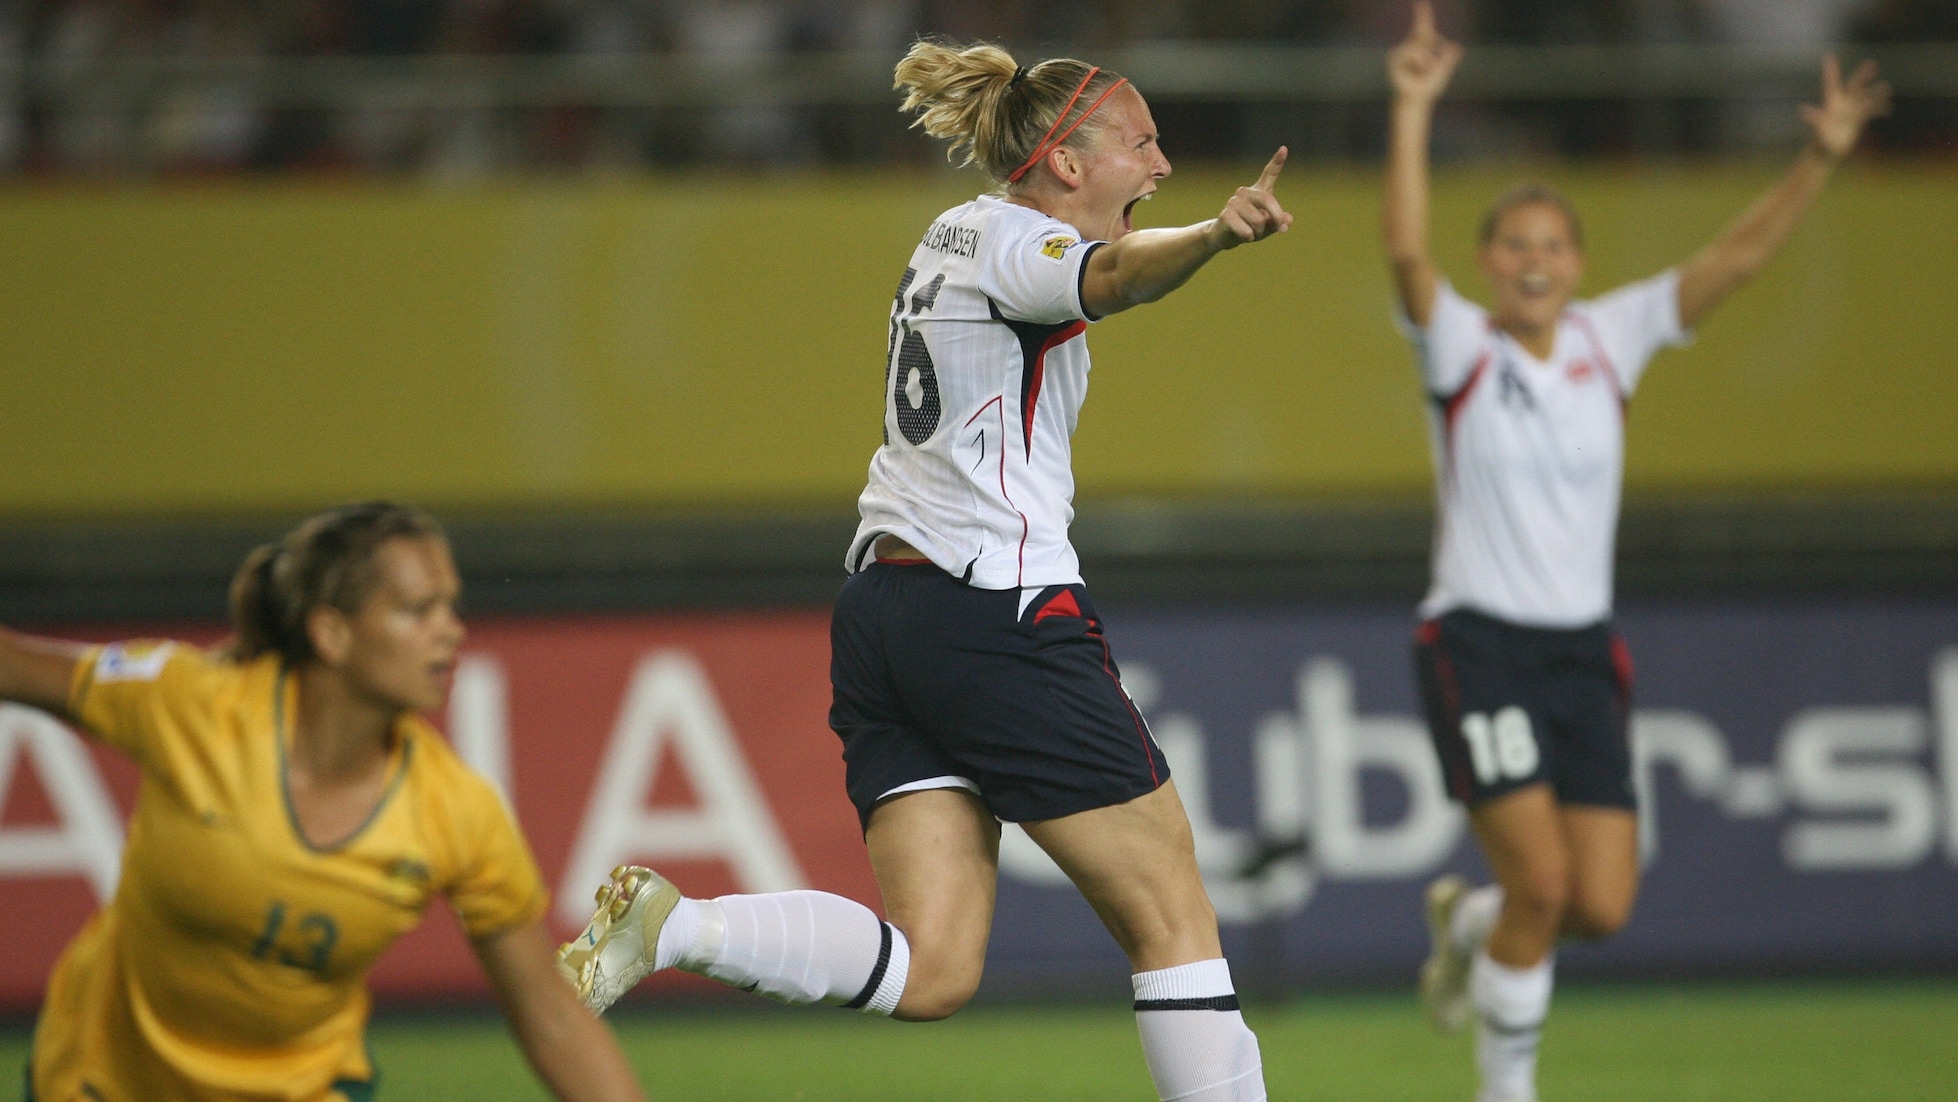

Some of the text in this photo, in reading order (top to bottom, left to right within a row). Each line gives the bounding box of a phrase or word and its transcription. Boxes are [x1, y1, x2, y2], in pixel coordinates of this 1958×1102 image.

[884, 267, 945, 446] 16
[1460, 705, 1540, 785] 18
[252, 899, 339, 977] 13
